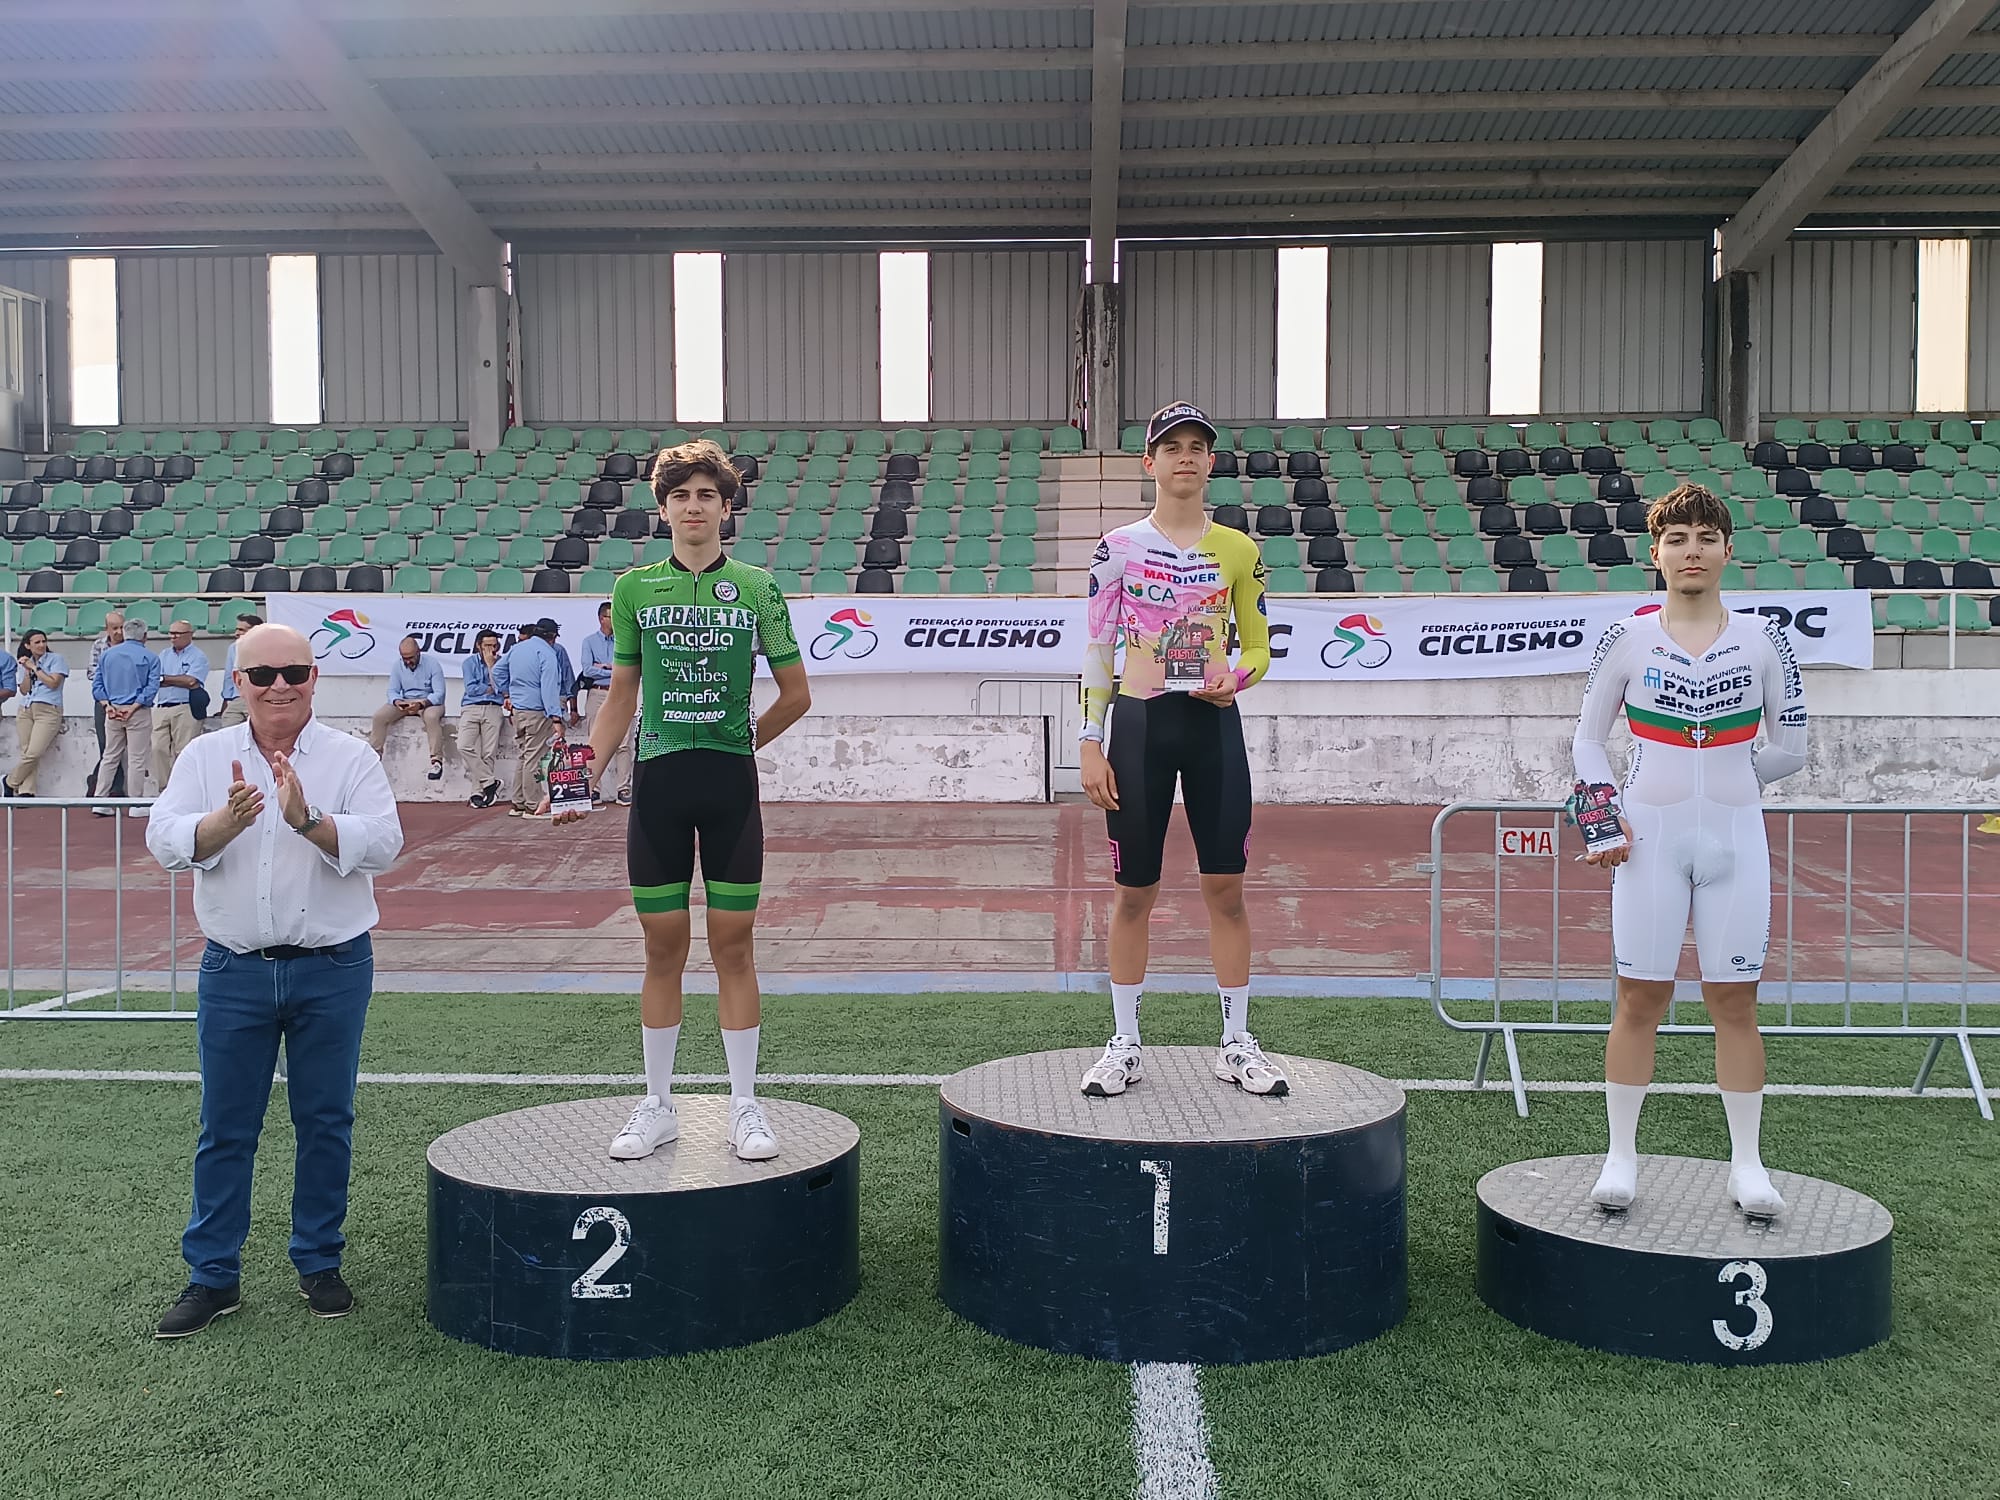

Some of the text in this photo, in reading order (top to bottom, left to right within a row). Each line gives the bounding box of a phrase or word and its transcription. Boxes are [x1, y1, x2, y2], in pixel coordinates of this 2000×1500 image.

[1144, 569, 1217, 585] MATDIVER
[1148, 585, 1177, 604] CA
[405, 621, 470, 631] FEDERAÇÃO
[908, 617, 1066, 628] FEDERAÇÃO PORTUGUESA DE
[1421, 618, 1586, 635] FEDERAÇÃO PORTUGUESA DE
[656, 628, 734, 647] anadia
[904, 628, 1061, 648] CICLISMO
[1418, 630, 1585, 658] CICLISMO
[661, 657, 691, 669] Quinta
[675, 667, 728, 682] Abibes
[1706, 664, 1753, 683] MUNICIPAL
[1664, 674, 1752, 699] PAREDES
[662, 688, 720, 705] primefix
[1502, 831, 1553, 854] CMA
[1140, 1160, 1172, 1256] 1
[571, 1206, 632, 1300] 2
[1712, 1260, 1774, 1351] 3
